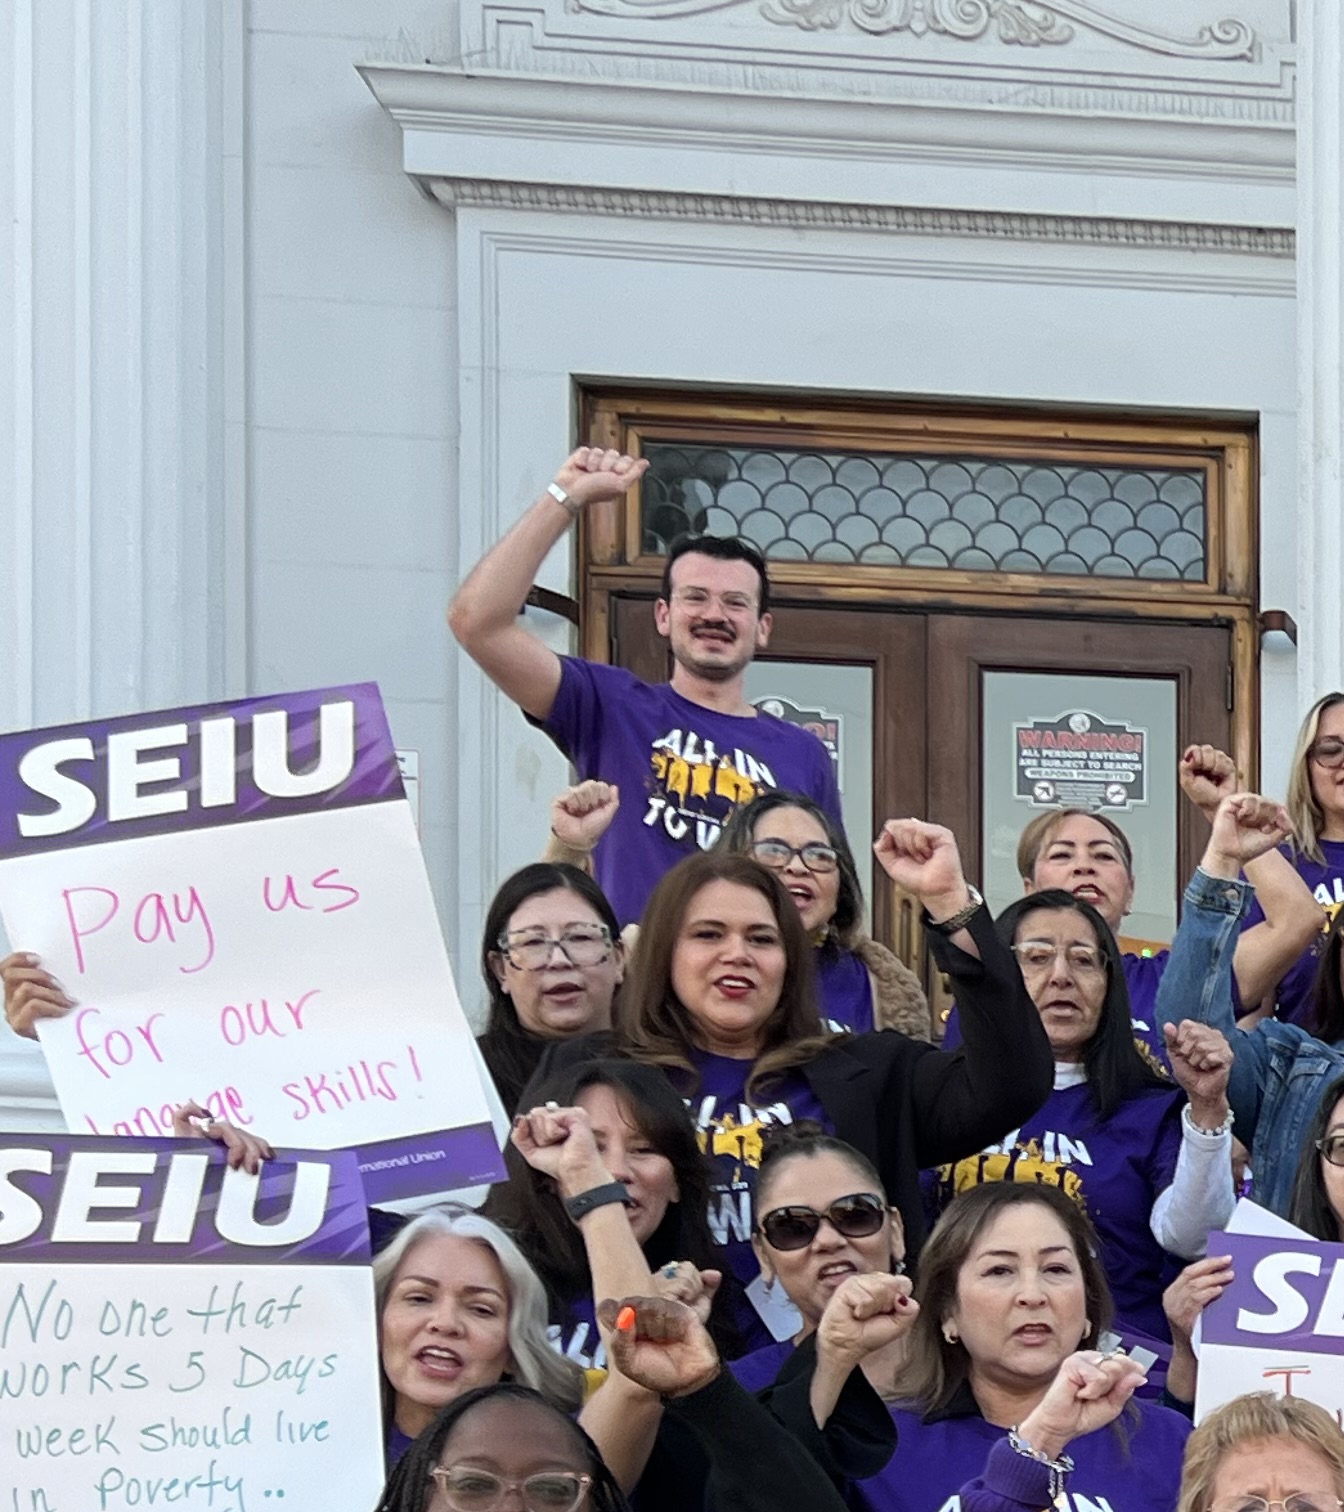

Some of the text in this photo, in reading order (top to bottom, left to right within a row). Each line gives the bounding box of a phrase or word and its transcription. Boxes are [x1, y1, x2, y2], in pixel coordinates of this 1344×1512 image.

[16, 700, 354, 837] SEIU
[734, 748, 777, 788] IN
[1019, 730, 1142, 752] WARNING!
[62, 868, 359, 974] Pay us
[74, 989, 322, 1079] for our
[1043, 1130, 1093, 1166] IN
[0, 1149, 330, 1247] SEIU
[2, 1279, 303, 1349] No one that
[169, 1345, 338, 1395] 5 Days
[276, 1409, 331, 1445] live
